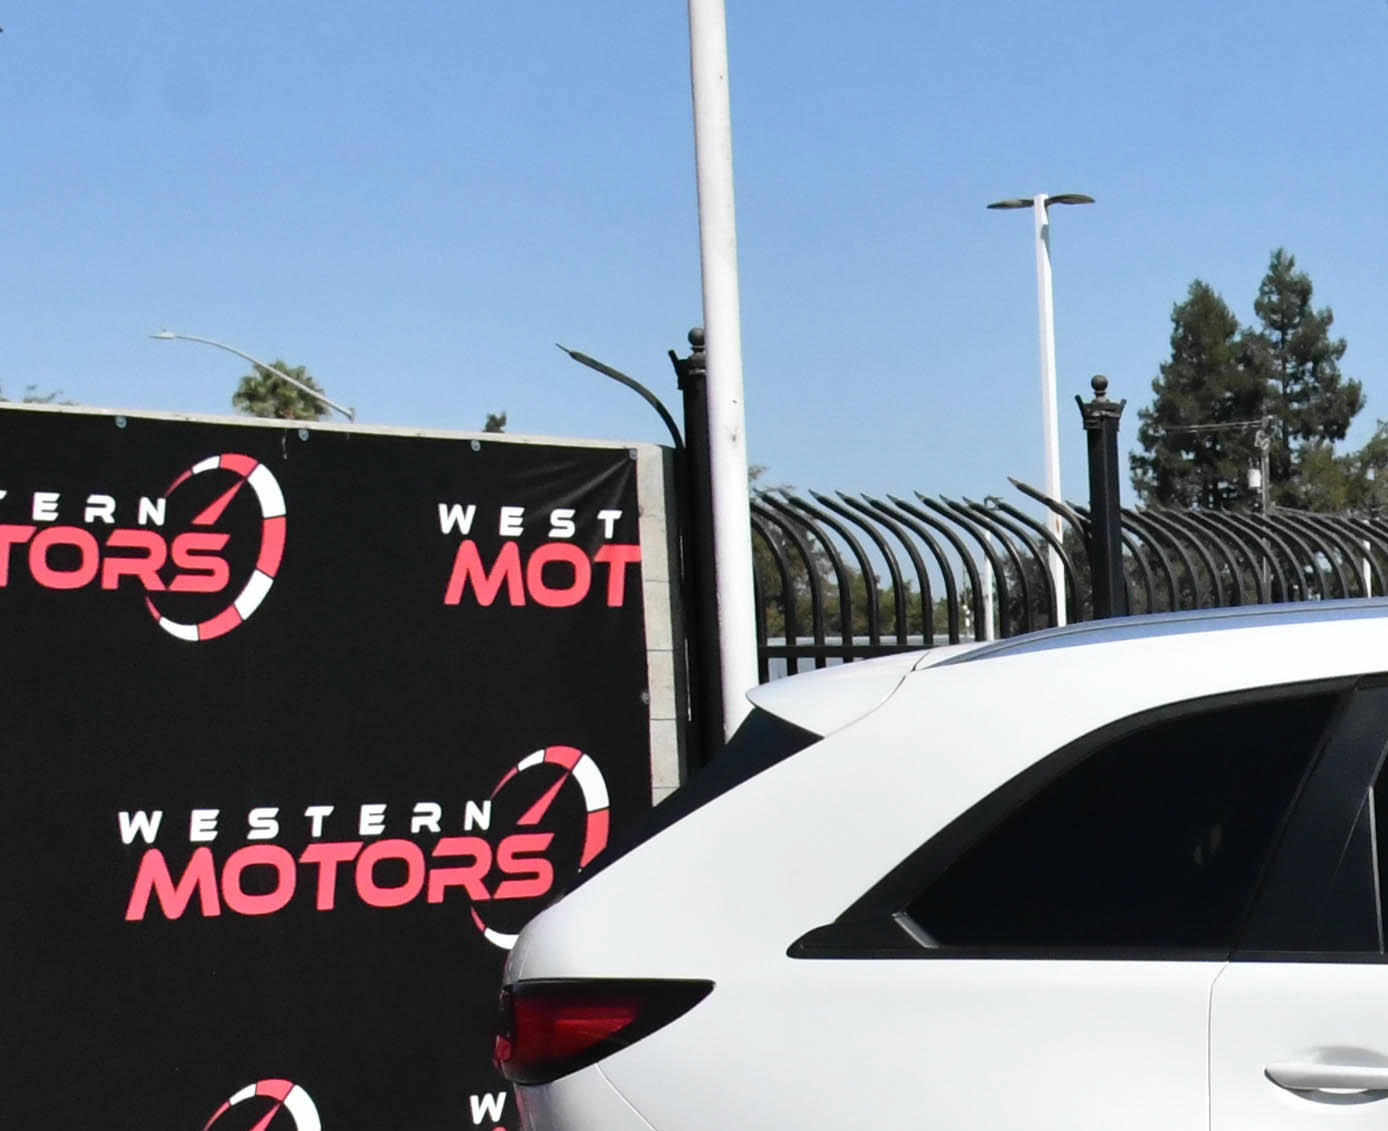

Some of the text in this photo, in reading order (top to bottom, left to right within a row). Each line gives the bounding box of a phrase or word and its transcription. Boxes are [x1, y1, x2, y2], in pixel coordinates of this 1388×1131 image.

[0, 489, 166, 526] ERN
[438, 503, 623, 539] WEST
[443, 539, 643, 608] MOT
[118, 800, 492, 845] WESTERN
[125, 832, 556, 921] MOTORS
